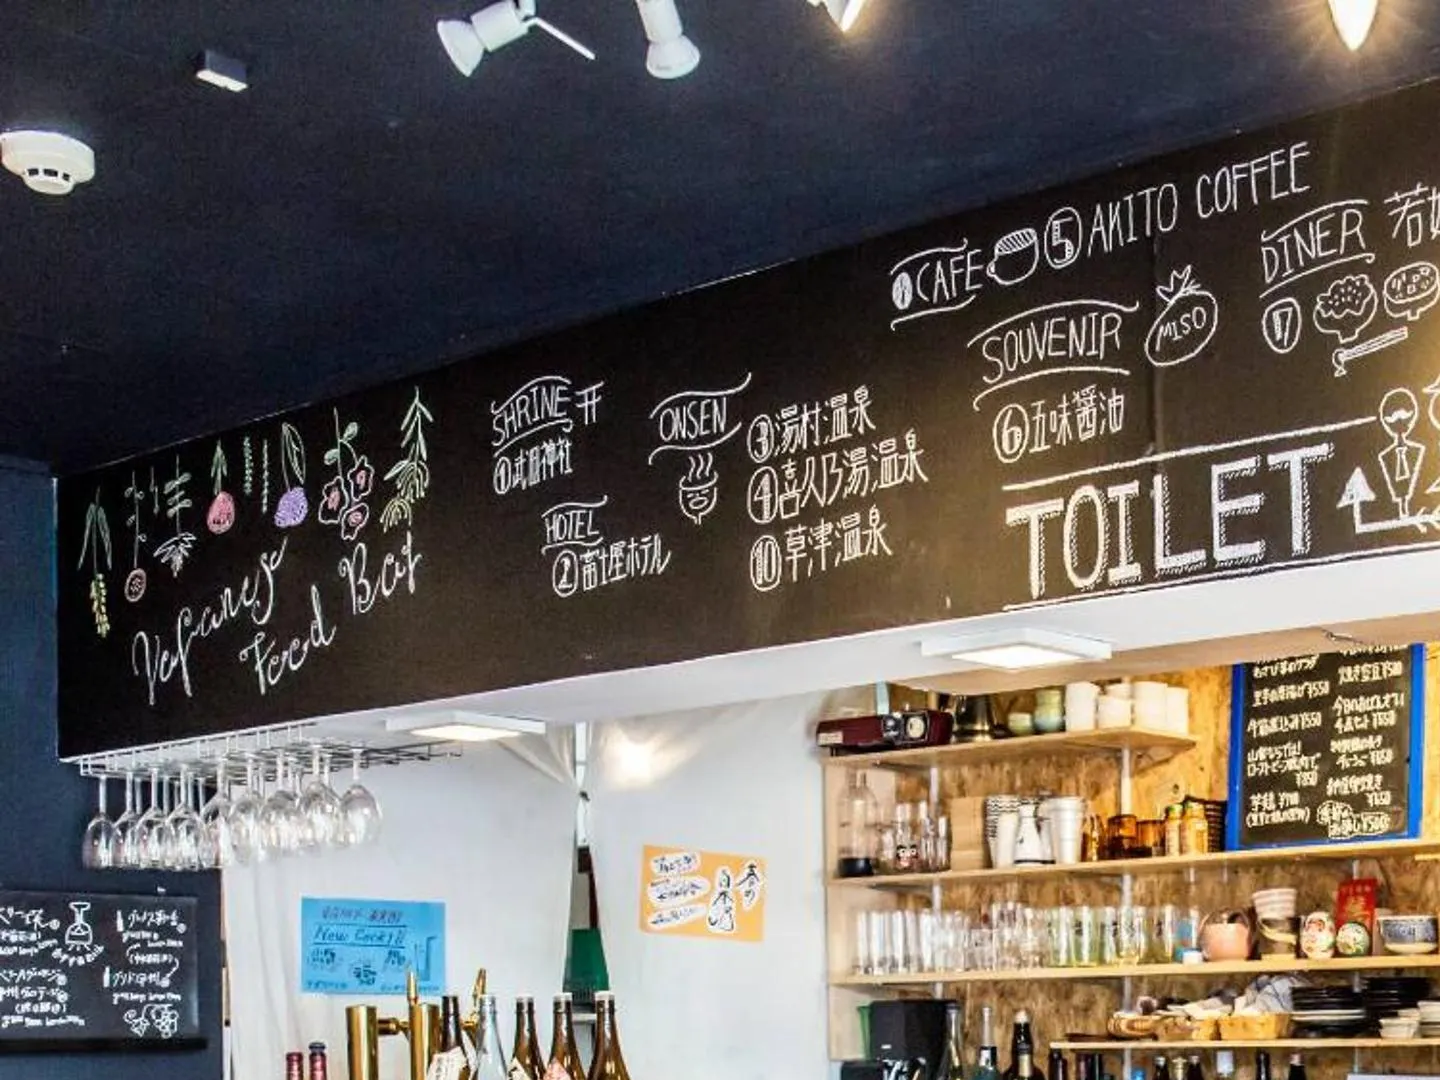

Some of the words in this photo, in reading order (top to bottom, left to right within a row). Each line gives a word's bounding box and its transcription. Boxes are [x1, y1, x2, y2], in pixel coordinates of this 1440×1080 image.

[1196, 142, 1310, 219] COFFEE
[916, 248, 984, 303] CAFE
[1261, 209, 1367, 284] DINER
[982, 312, 1123, 384] SOUVENIR
[1155, 307, 1207, 352] MISO
[492, 385, 571, 446] SHRINE
[659, 397, 728, 442] ONSEN
[545, 510, 600, 544] HOTEL
[1004, 443, 1335, 600] TOILET
